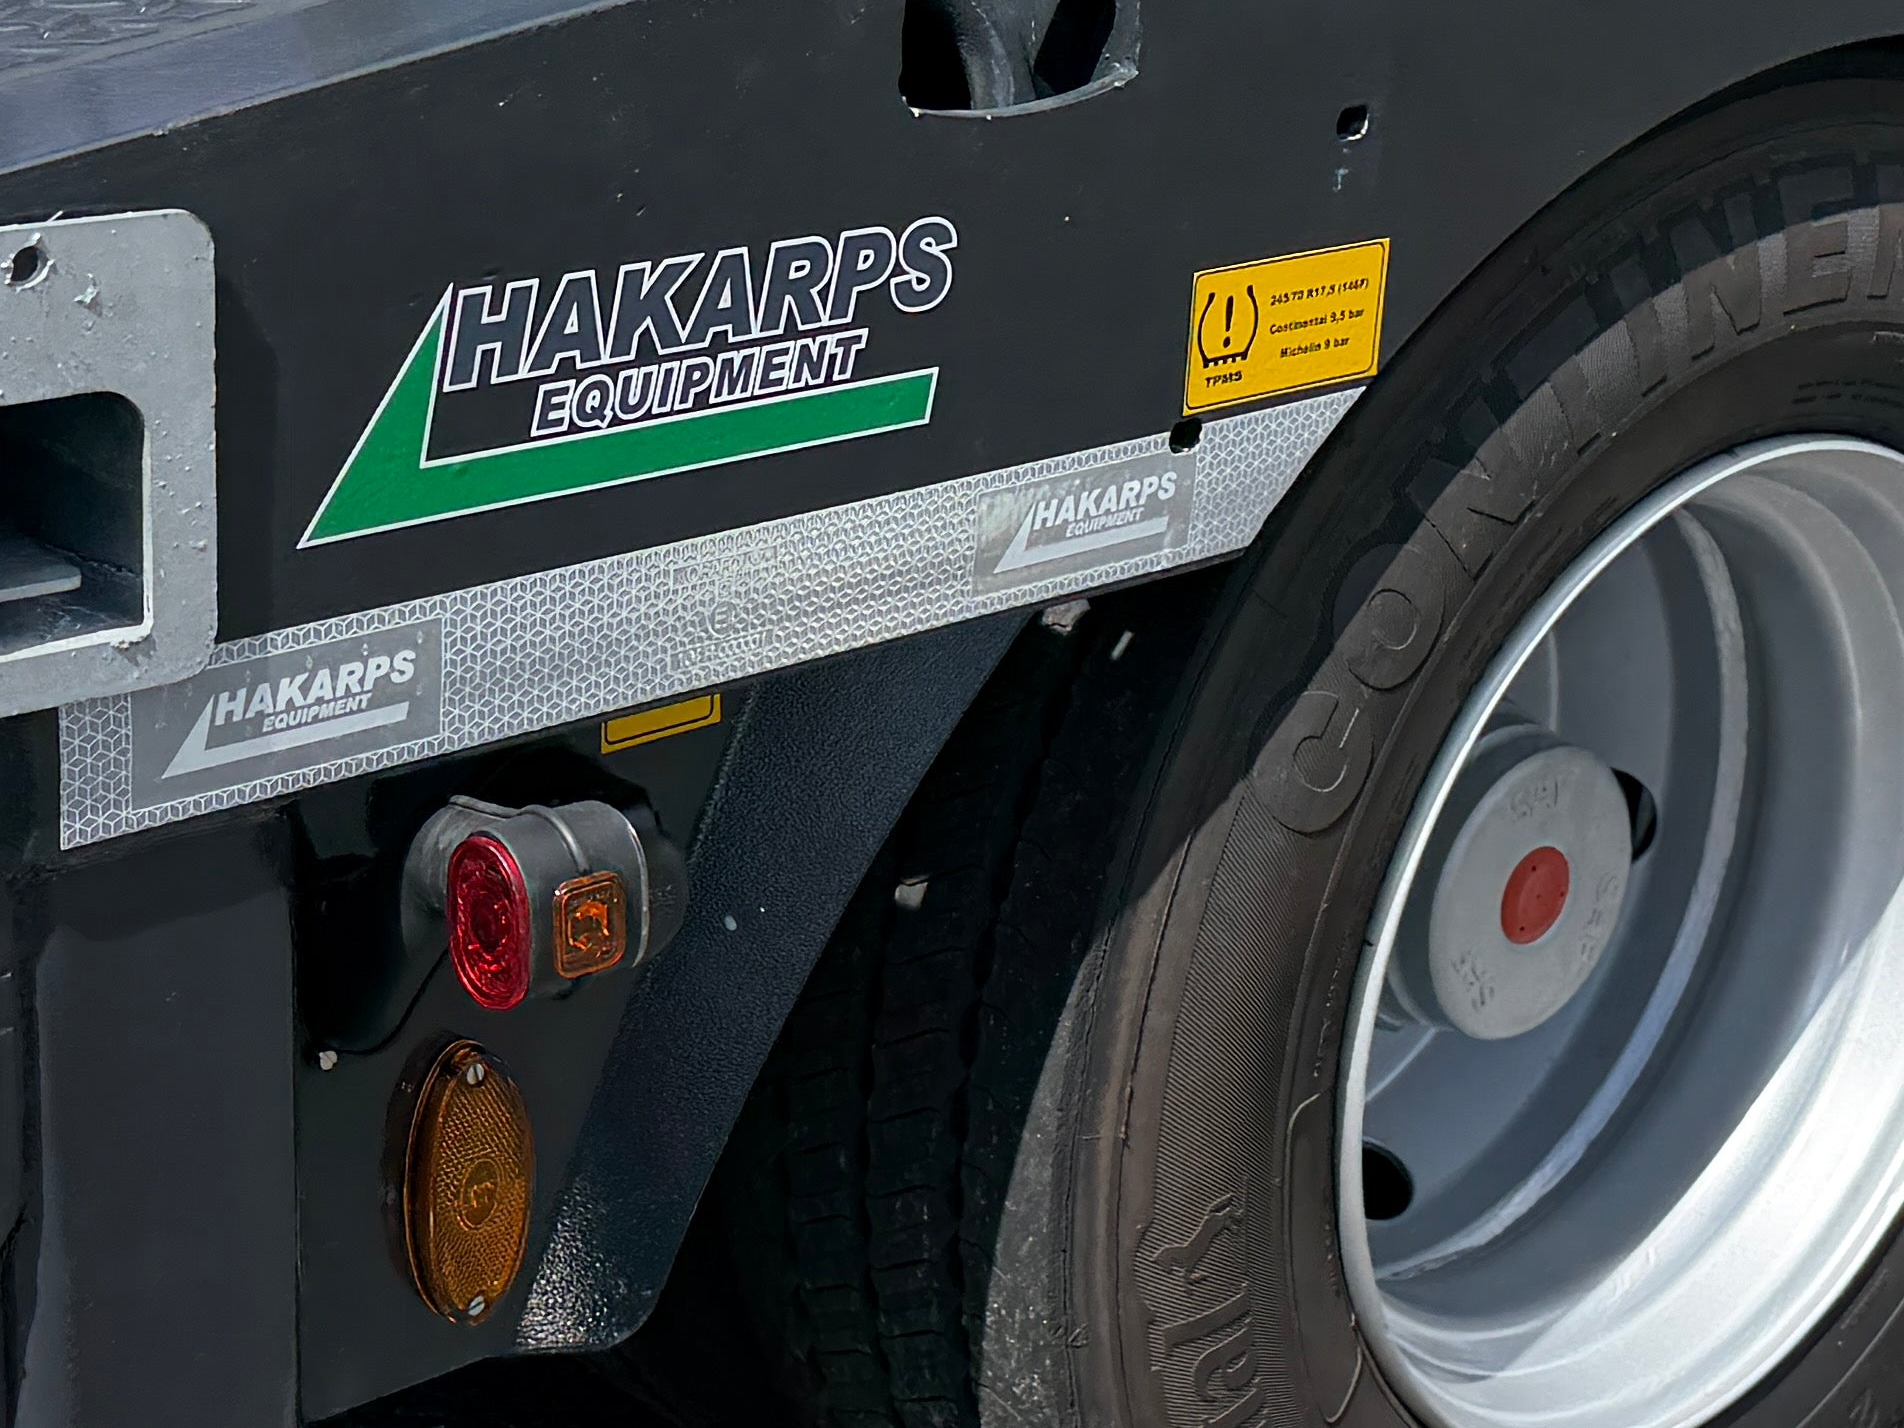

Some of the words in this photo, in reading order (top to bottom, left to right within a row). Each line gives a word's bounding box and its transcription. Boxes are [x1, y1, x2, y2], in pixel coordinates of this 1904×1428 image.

[443, 215, 959, 393] HAKARPS
[530, 327, 870, 438] EQUIPMENT
[1204, 371, 1243, 389] TPMS
[1033, 471, 1178, 531] HAKARPS
[1065, 506, 1145, 539] EQUIPMENT
[214, 649, 417, 726] HAKARPS
[261, 693, 373, 733] EQUIPMENT
